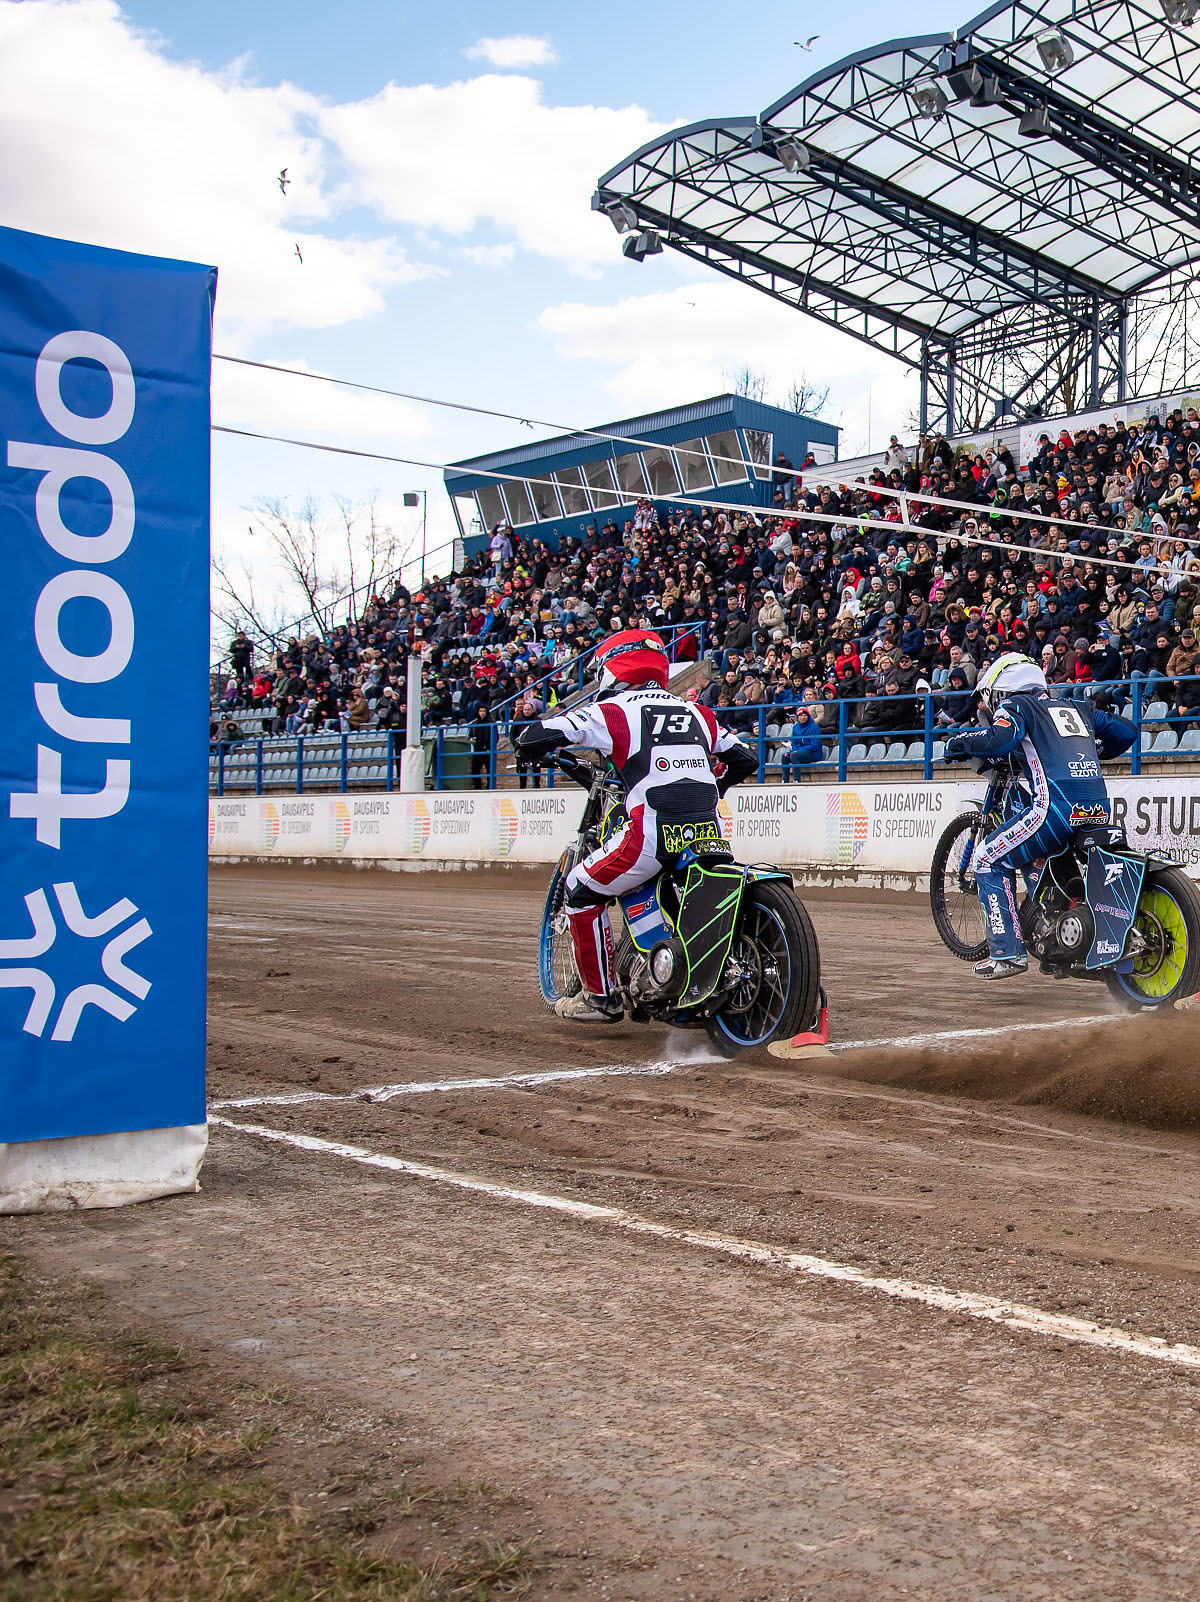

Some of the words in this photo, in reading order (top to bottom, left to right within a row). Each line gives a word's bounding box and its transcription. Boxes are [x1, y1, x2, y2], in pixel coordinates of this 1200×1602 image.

[6, 329, 136, 848] trodo
[651, 714, 692, 735] 13
[1059, 709, 1081, 733] 3
[672, 758, 706, 769] OPTIBET
[281, 803, 315, 816] DAUGAVPILS
[353, 801, 390, 816] DAUGAVPILS
[433, 800, 475, 815] DAUGAVPILS
[521, 799, 566, 814] DAUGAVPILS
[737, 795, 798, 813] DAUGAVPILS
[873, 792, 943, 812] DAUGAVPILS
[359, 820, 380, 834] SPORTS
[440, 820, 471, 834] SPEEDWAY
[520, 820, 527, 835] IR
[528, 820, 553, 836] SPORTS
[736, 819, 745, 837] IR
[747, 819, 781, 837] SPORTS
[872, 819, 882, 838] IS
[885, 819, 937, 838] SPEEDWAY
